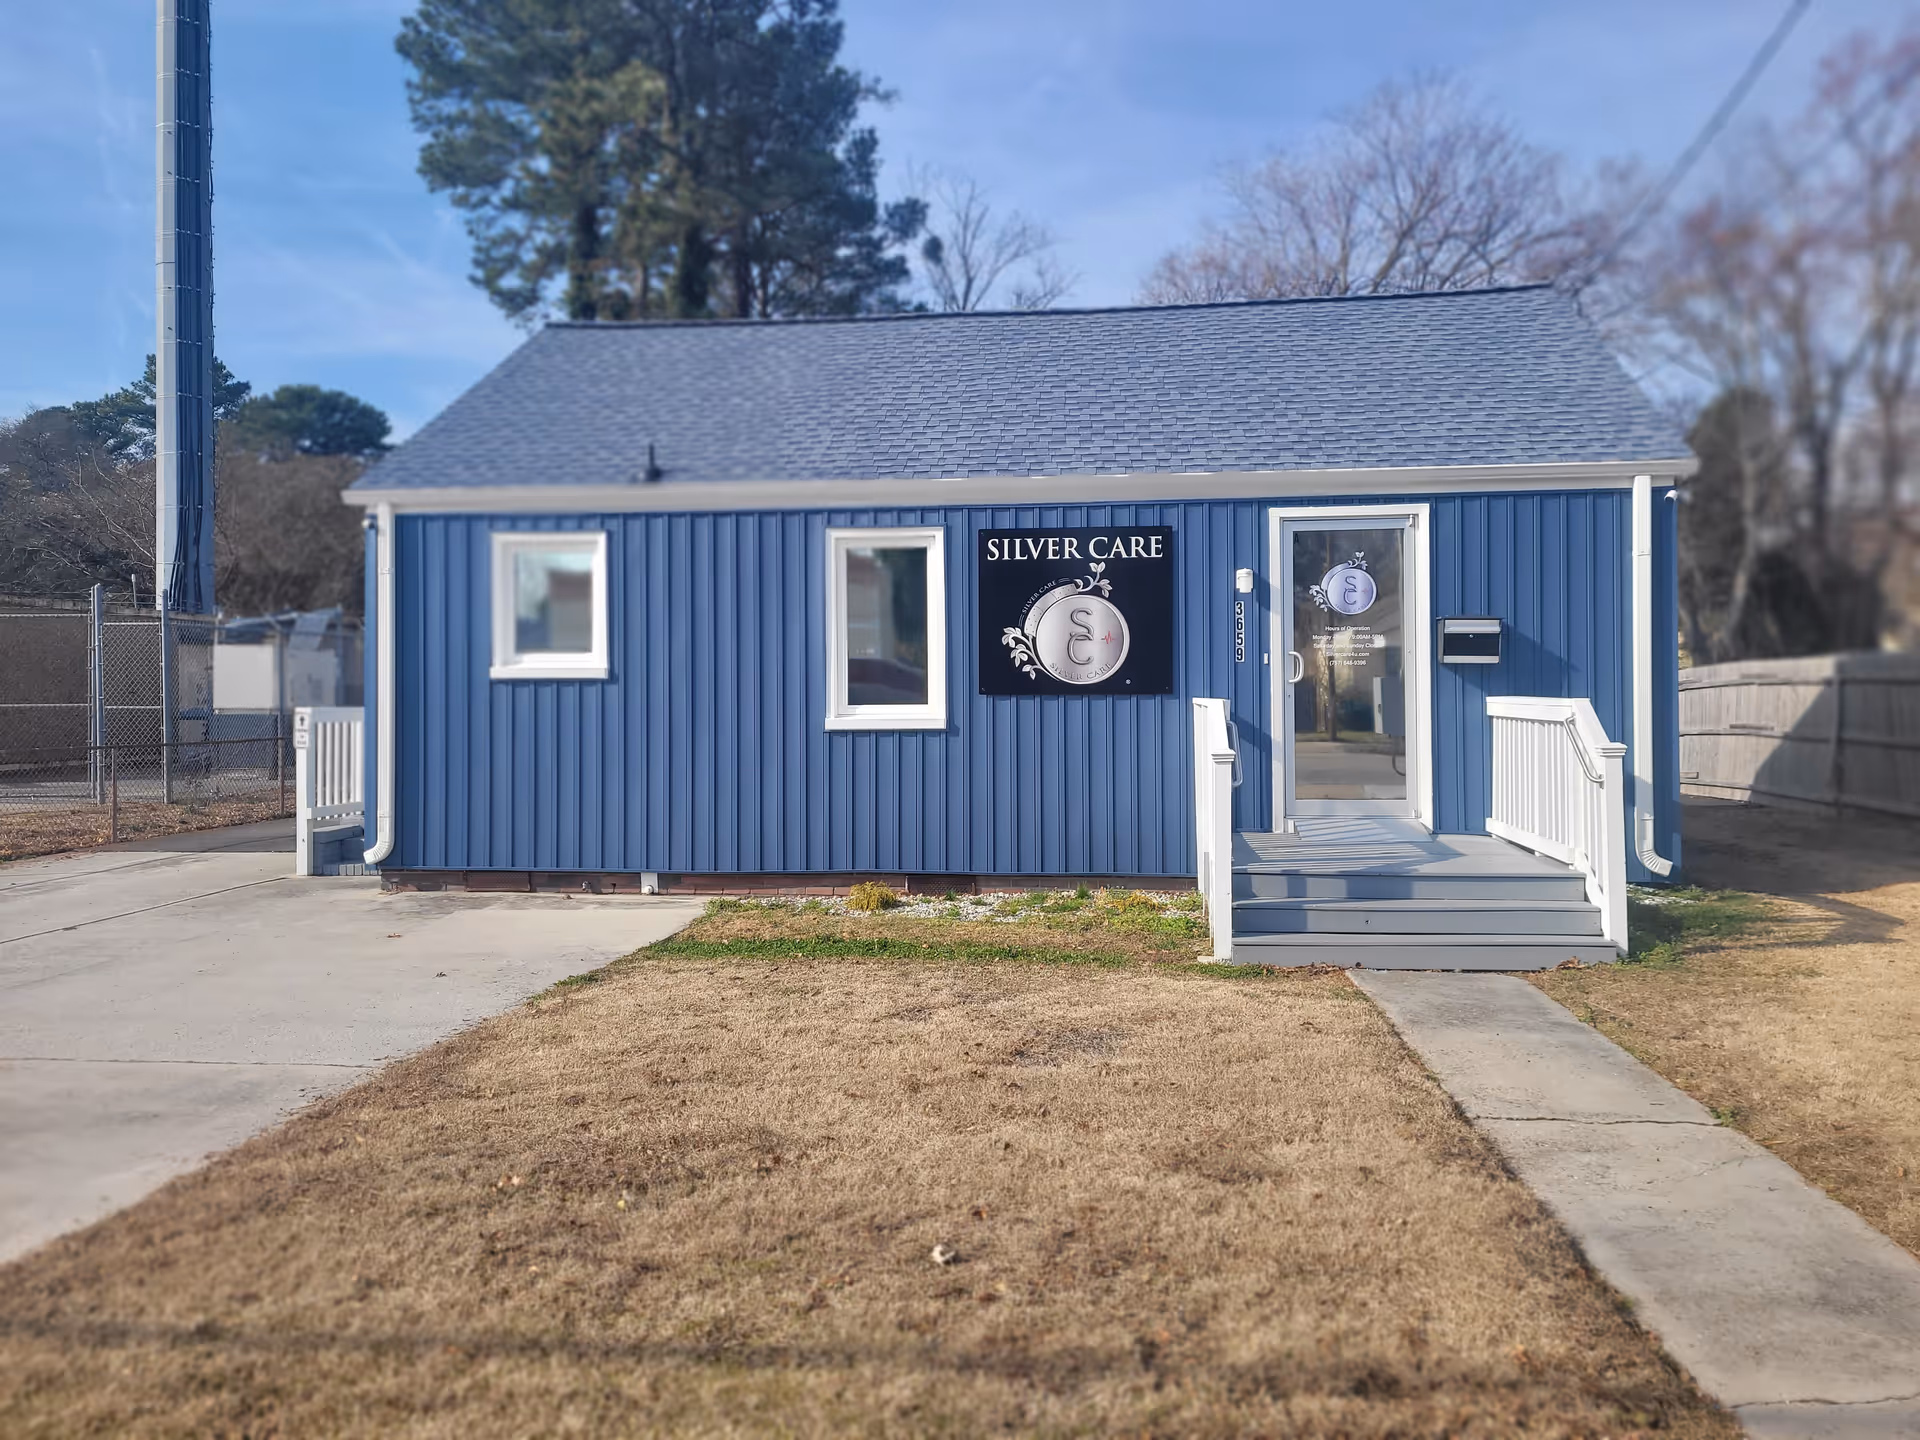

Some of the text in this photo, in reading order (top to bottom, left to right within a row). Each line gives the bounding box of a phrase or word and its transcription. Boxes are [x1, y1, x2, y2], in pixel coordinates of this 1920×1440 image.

[987, 535, 1164, 561] SILVER CARE
[1021, 579, 1056, 613] SILVER CARE
[1050, 662, 1111, 680] SILVER CARE
